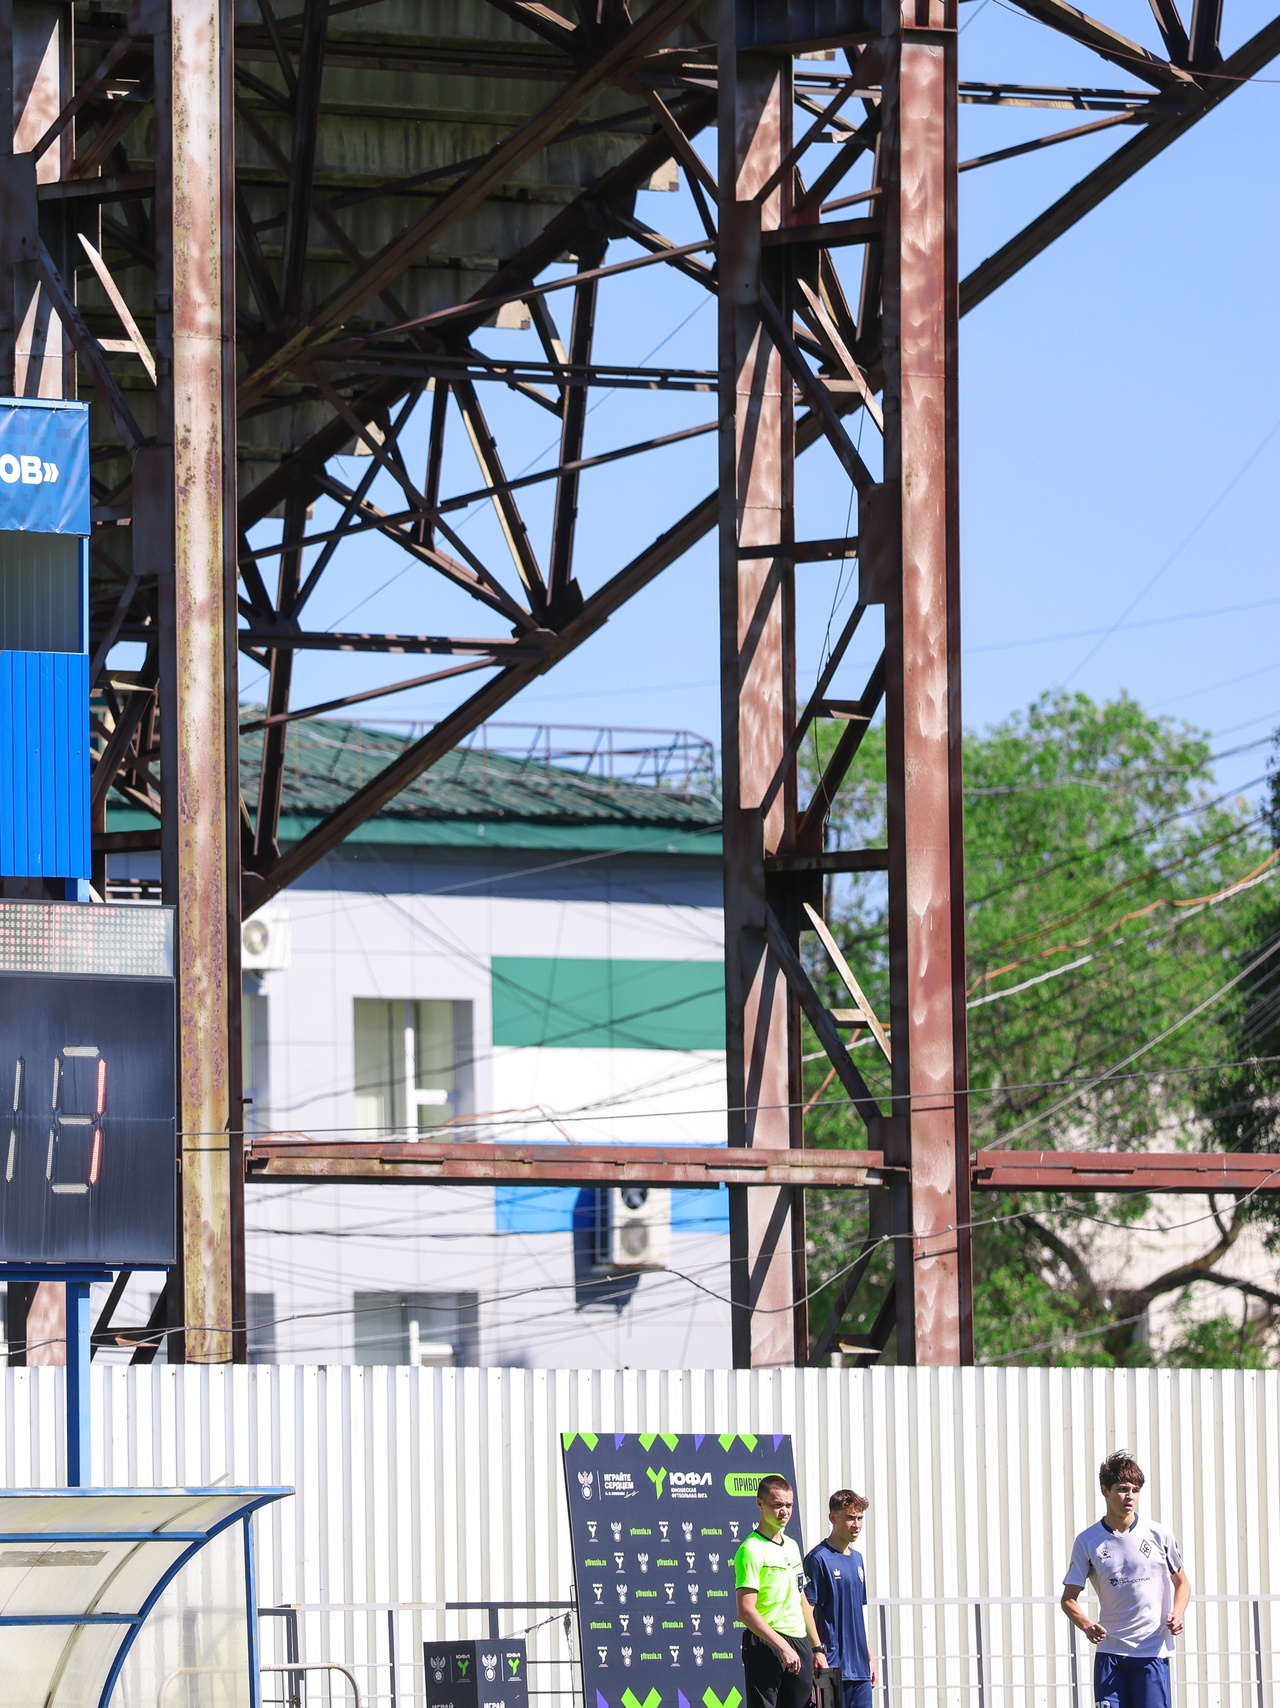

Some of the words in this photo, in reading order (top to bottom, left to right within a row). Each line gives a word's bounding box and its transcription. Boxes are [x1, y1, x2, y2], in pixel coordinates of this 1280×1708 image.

[604, 1472, 631, 1481] ИГРАЙТЕ
[669, 1472, 712, 1486] ЮФЛ
[604, 1482, 634, 1490] СЕРДЦЕМ
